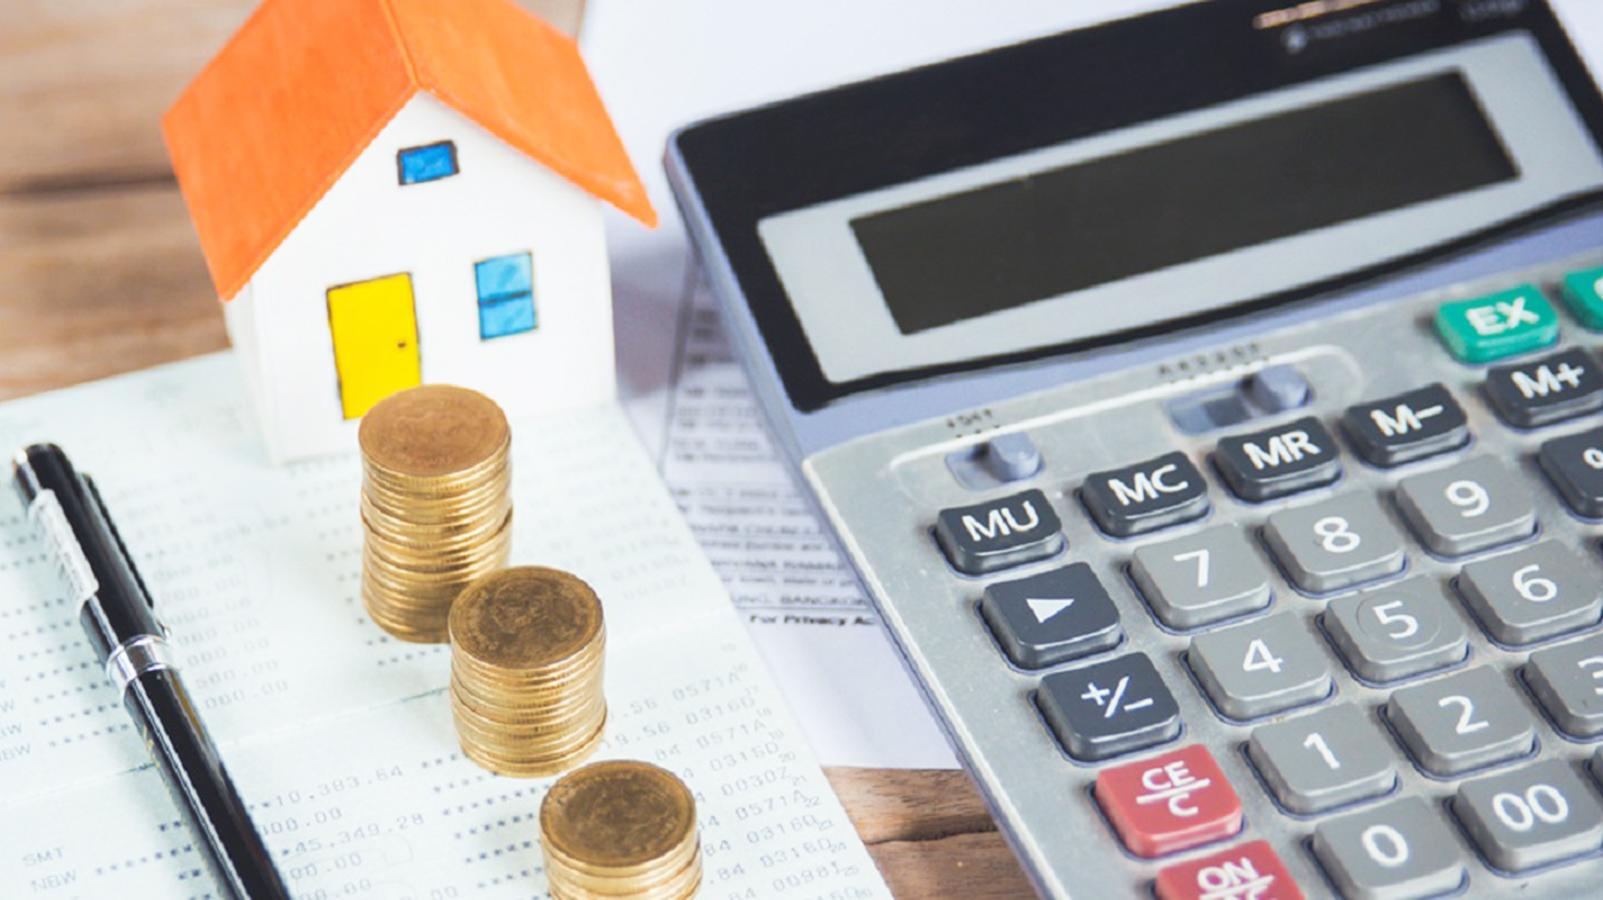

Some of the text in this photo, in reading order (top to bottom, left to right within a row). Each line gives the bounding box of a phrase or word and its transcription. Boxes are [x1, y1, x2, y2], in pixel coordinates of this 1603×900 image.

[1465, 295, 1540, 336] EX
[1511, 362, 1584, 399] M+
[1243, 430, 1321, 470] MR
[1108, 463, 1188, 506] MC
[1445, 479, 1490, 517] 9
[961, 500, 1040, 542] MU
[1313, 516, 1361, 553] 8
[1173, 549, 1210, 588] 7
[1512, 563, 1558, 602] 6
[783, 615, 847, 626] Privacy
[1372, 600, 1419, 639] 5
[1242, 638, 1284, 674] 4
[696, 719, 767, 749] 0571A
[1438, 695, 1489, 735] 2
[1303, 732, 1341, 770] 1
[1141, 760, 1196, 791] CE
[735, 789, 807, 821] 0571A
[1168, 791, 1199, 817] C
[1492, 784, 1570, 832] 00
[20, 845, 65, 867] SMT
[1361, 824, 1409, 867] 0
[29, 868, 78, 893] NBW
[1197, 857, 1260, 890] ON
